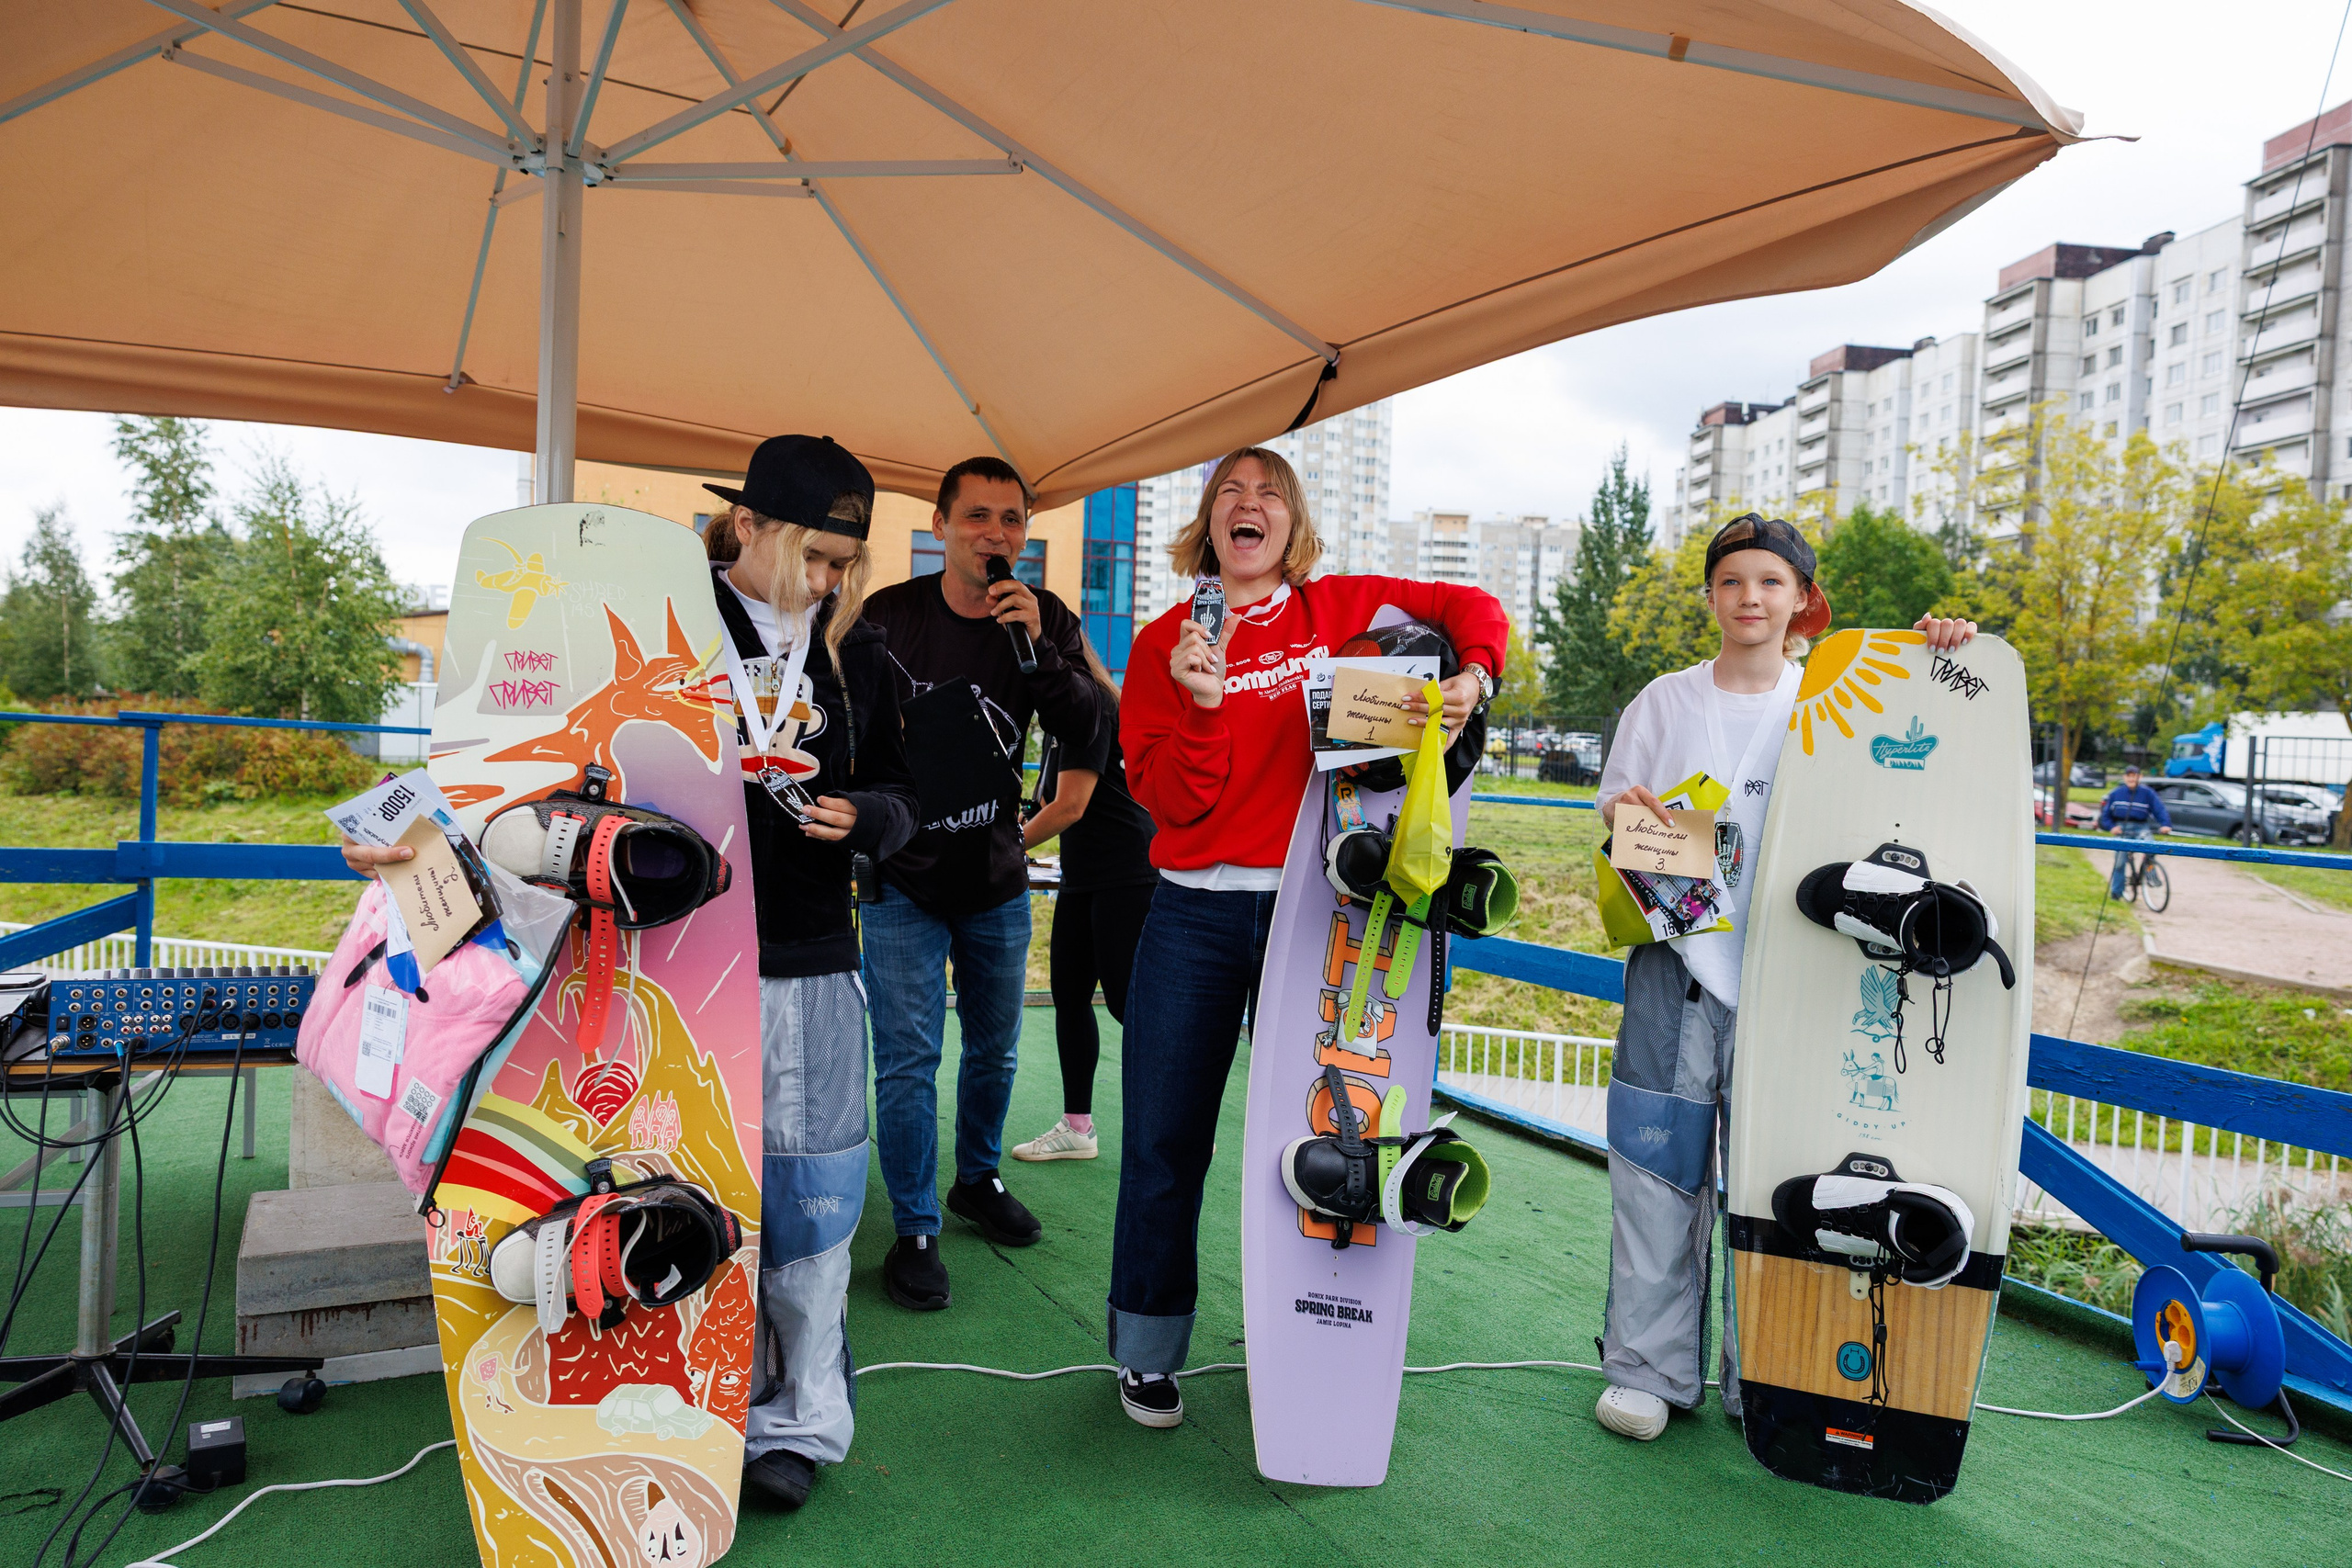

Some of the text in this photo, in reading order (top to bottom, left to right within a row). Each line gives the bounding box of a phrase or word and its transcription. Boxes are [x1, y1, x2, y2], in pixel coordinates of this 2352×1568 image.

[1312, 691, 1333, 701] ПОДАР
[1352, 688, 1404, 710] Любители
[1346, 710, 1392, 725] женщины
[1873, 740, 1933, 760] Hyperlite
[1625, 818, 1689, 840] Любители
[1634, 843, 1679, 856] женщины
[413, 874, 440, 931] Любители
[1307, 1292, 1362, 1305] RONIX PARK DIVISION
[1295, 1299, 1374, 1324] SPRING BREAK
[1317, 1318, 1351, 1329] JAMIE LOPINA
